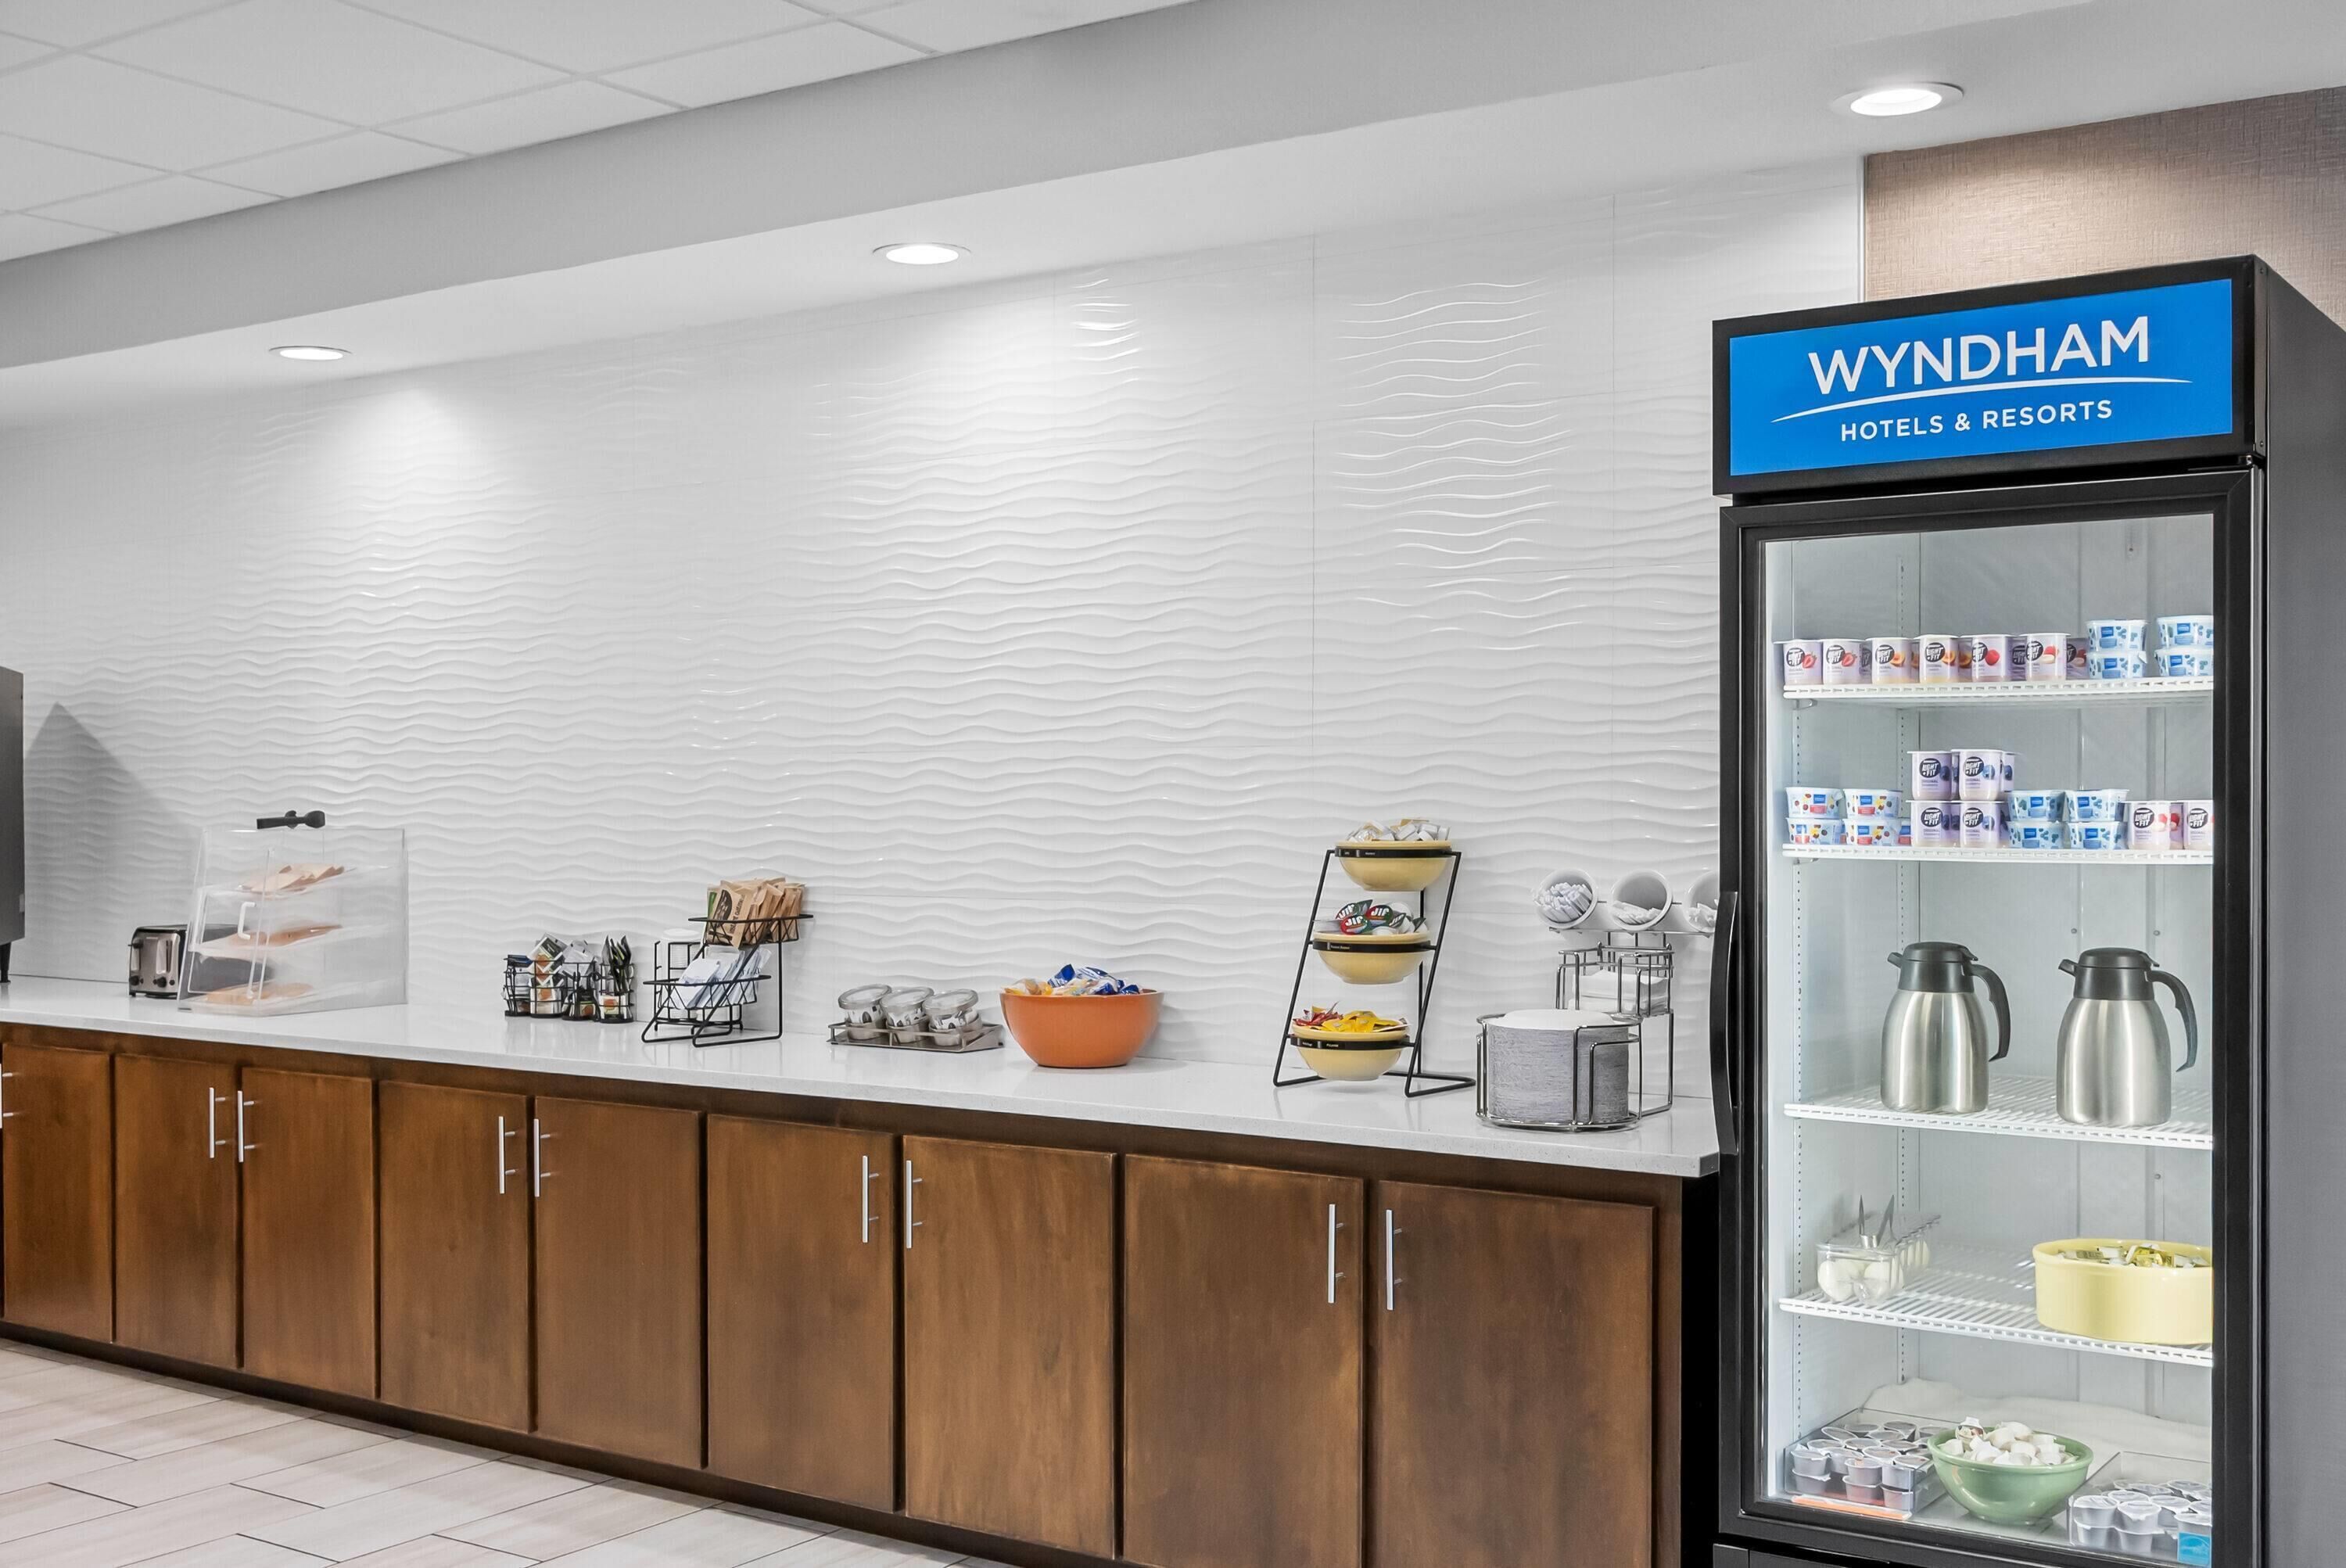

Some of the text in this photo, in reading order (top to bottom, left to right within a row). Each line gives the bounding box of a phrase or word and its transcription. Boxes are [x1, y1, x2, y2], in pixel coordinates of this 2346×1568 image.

[1808, 316, 2149, 395] WYNDHAM
[1842, 400, 2112, 441] HOTELS & RESORTS
